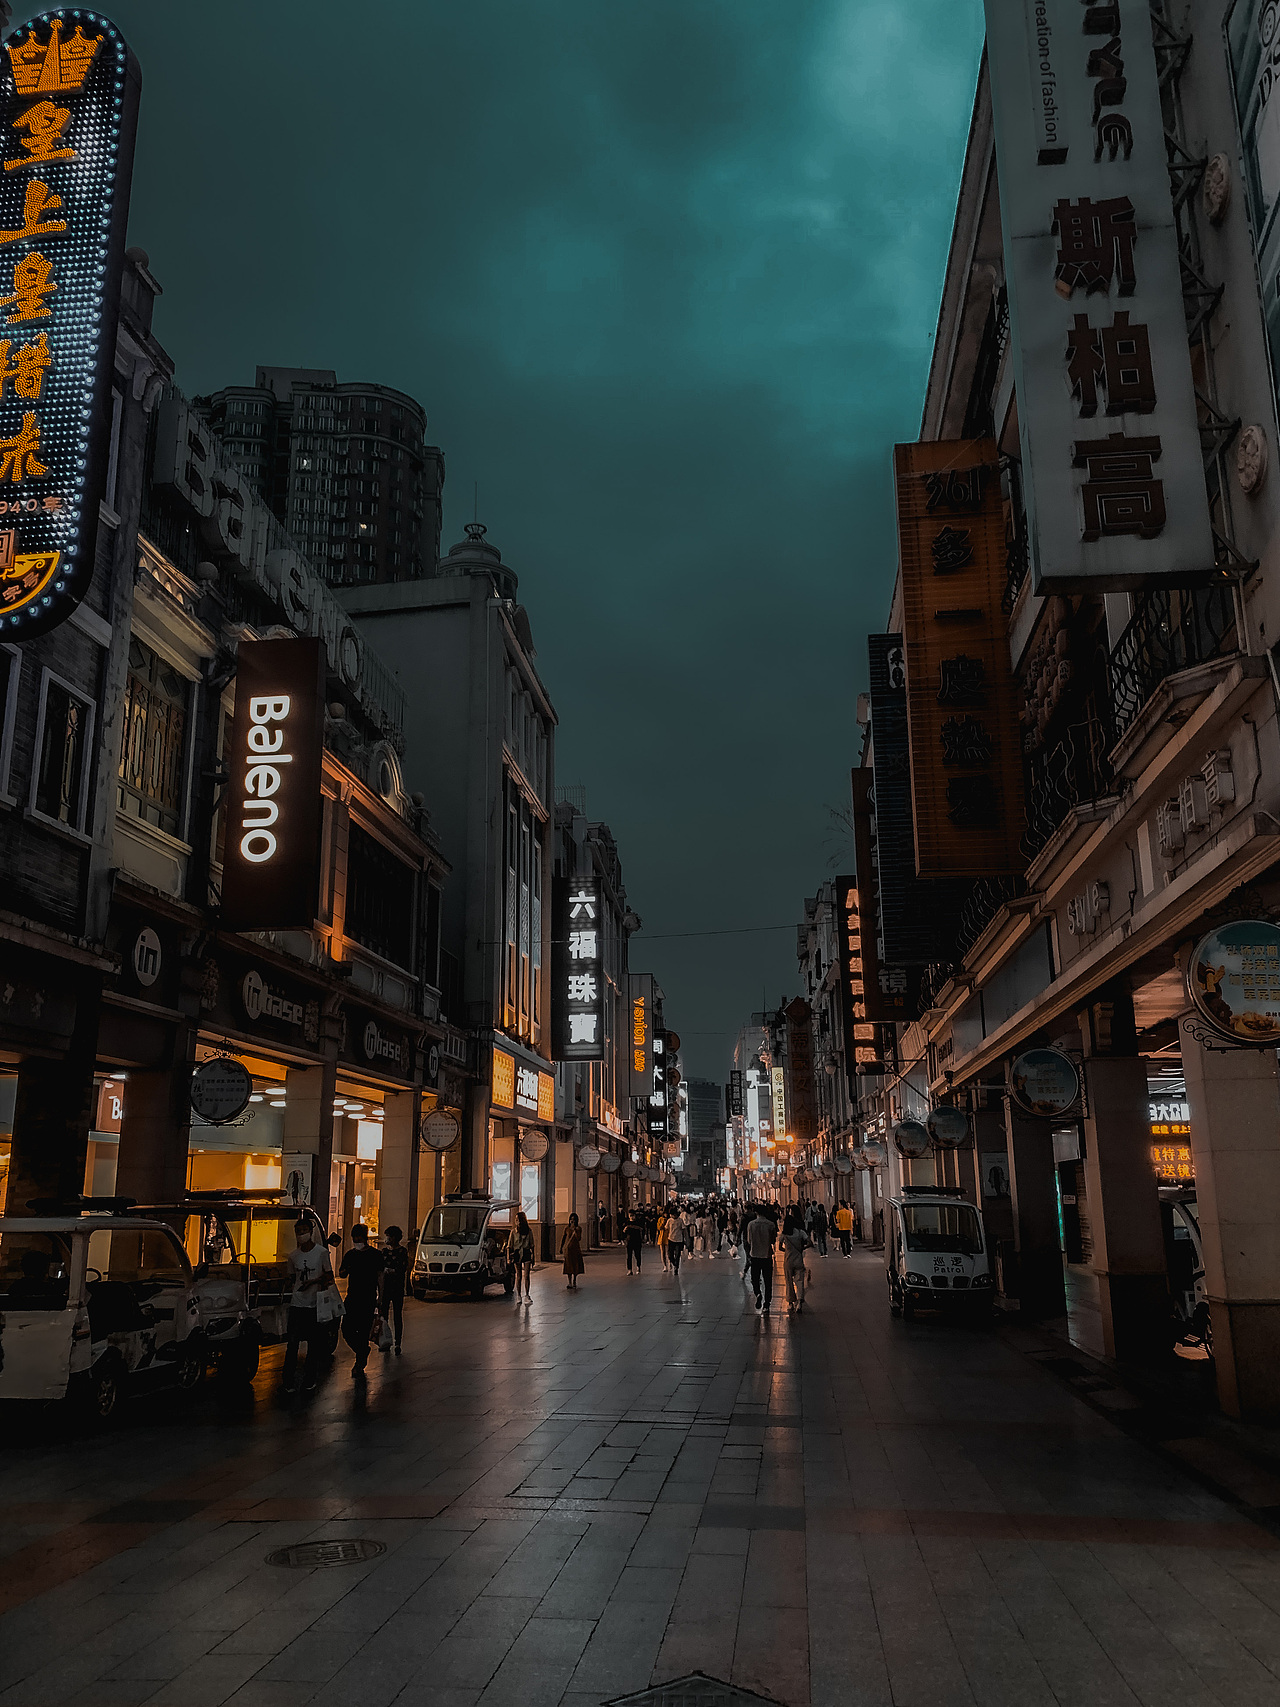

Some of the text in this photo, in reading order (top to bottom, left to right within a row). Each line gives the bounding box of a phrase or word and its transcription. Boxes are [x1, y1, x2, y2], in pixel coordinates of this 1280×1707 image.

[1040, 62, 1053, 78] of
[1041, 80, 1059, 143] fashion
[1053, 196, 1167, 544] 斯柏高
[240, 695, 292, 862] Baleno
